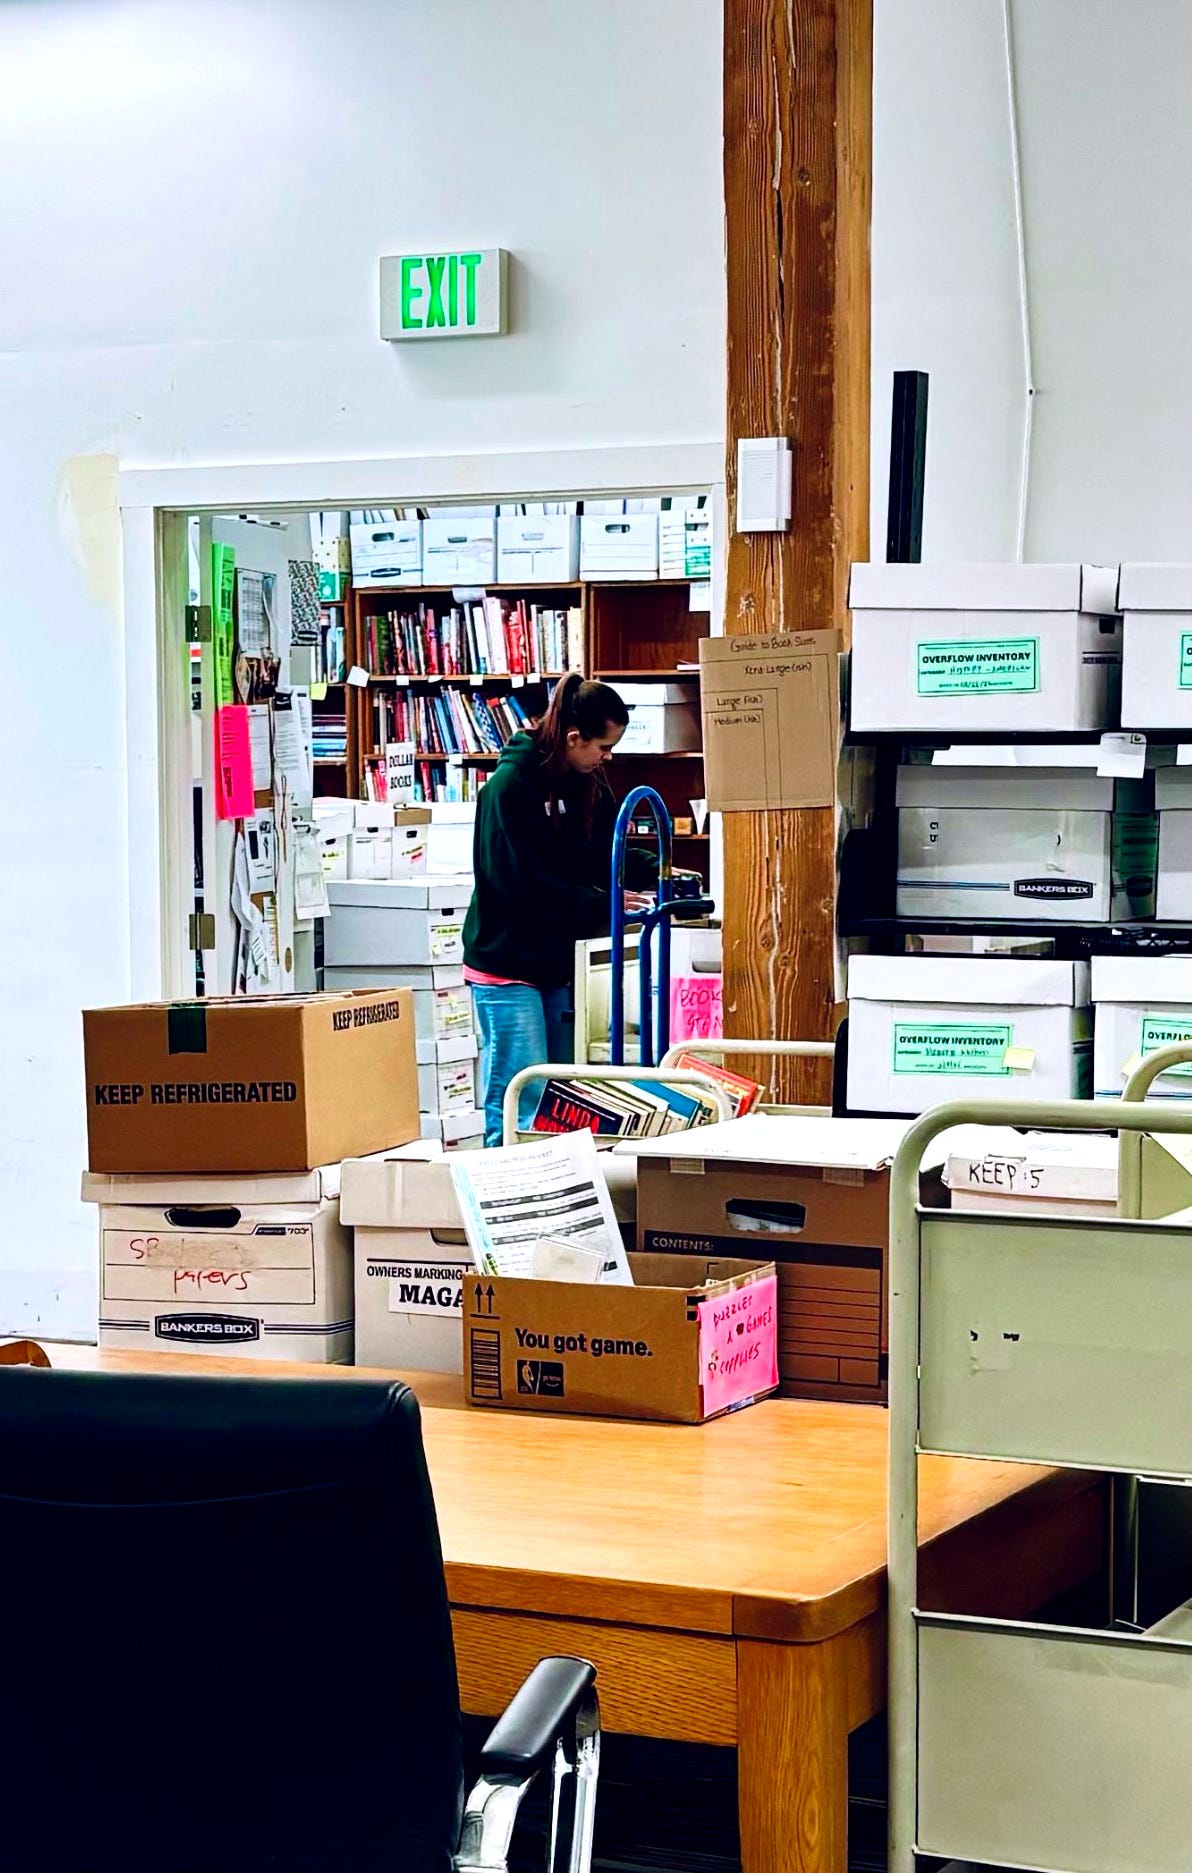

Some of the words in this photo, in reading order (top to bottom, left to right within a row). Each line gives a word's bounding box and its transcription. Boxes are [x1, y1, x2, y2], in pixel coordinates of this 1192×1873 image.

[401, 254, 481, 329] EXIT
[730, 639, 757, 652] Guide
[922, 654, 974, 664] OVERFLOW
[976, 652, 1031, 662] INVENTORY
[716, 697, 741, 711] Large
[1018, 884, 1066, 893] BANKERS
[1067, 886, 1089, 894] BOX
[332, 1009, 353, 1031] KEEP
[353, 1000, 400, 1027] REFRIGERATED
[899, 1035, 950, 1045] OVERFLOW
[951, 1036, 1005, 1046] INVENTORY
[95, 1084, 144, 1106] KEEP
[150, 1081, 297, 1105] REFRIGERATED
[968, 1162, 1017, 1190] KEEP
[651, 1236, 715, 1252] CONTENTS:
[366, 1265, 412, 1279] OWNERS
[414, 1267, 463, 1281] MARKING
[160, 1321, 222, 1334] BANKERS
[224, 1323, 254, 1335] BOX
[746, 1306, 773, 1334] GAMES
[514, 1327, 549, 1349] You
[553, 1333, 588, 1354] got
[590, 1337, 653, 1357] game.
